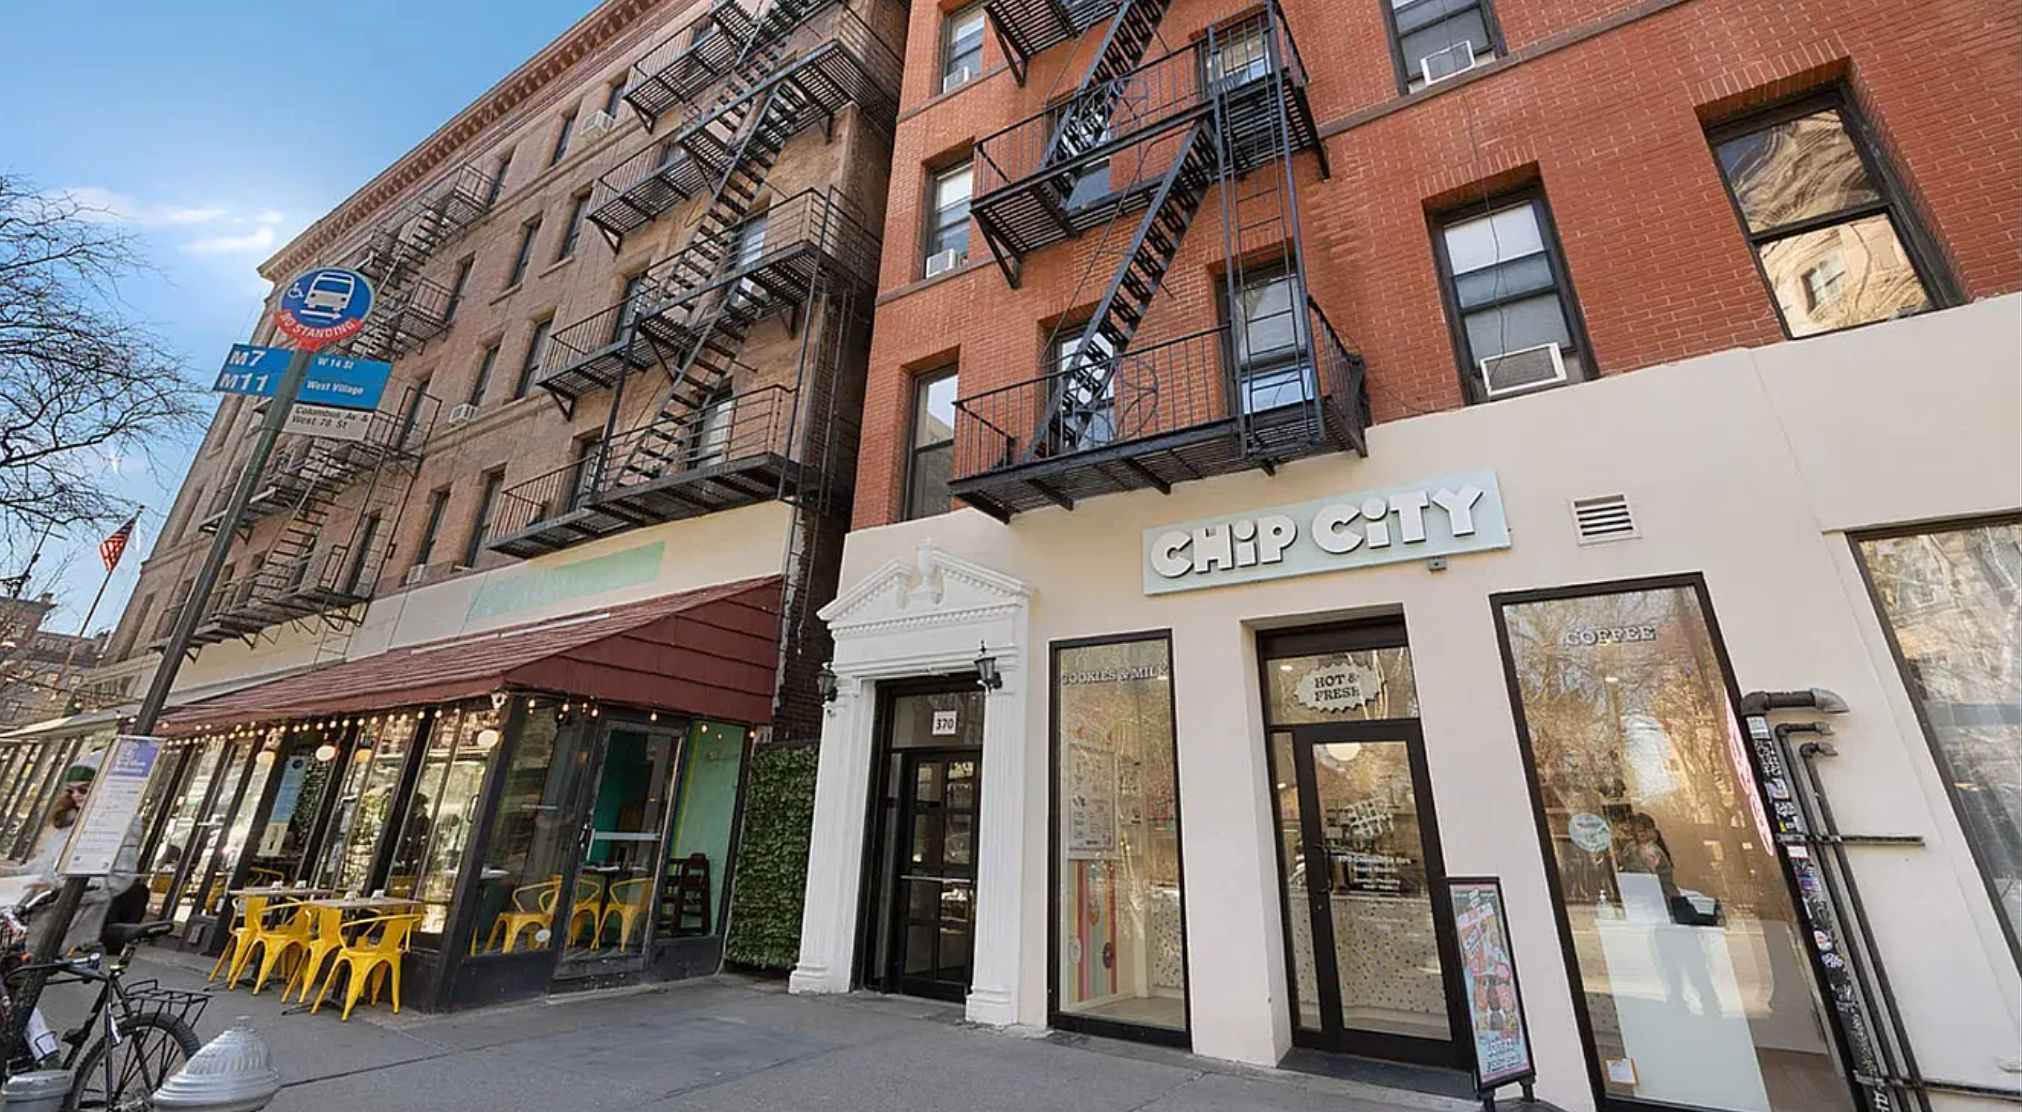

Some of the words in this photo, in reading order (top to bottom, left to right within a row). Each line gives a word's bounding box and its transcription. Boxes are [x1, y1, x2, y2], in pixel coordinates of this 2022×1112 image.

[280, 311, 294, 326] NO
[293, 319, 355, 339] STANDING
[229, 350, 265, 367] M7
[317, 357, 328, 366] W
[343, 360, 354, 370] St
[219, 373, 269, 392] M11
[306, 380, 330, 391] West
[332, 382, 364, 396] Village
[292, 415, 317, 426] West
[1564, 625, 1657, 646] COFFEE
[1061, 670, 1118, 686] COOKIES
[1314, 674, 1345, 688] HOT
[1348, 672, 1360, 684] &
[1314, 686, 1360, 702] FRESH
[936, 718, 955, 730] 370
